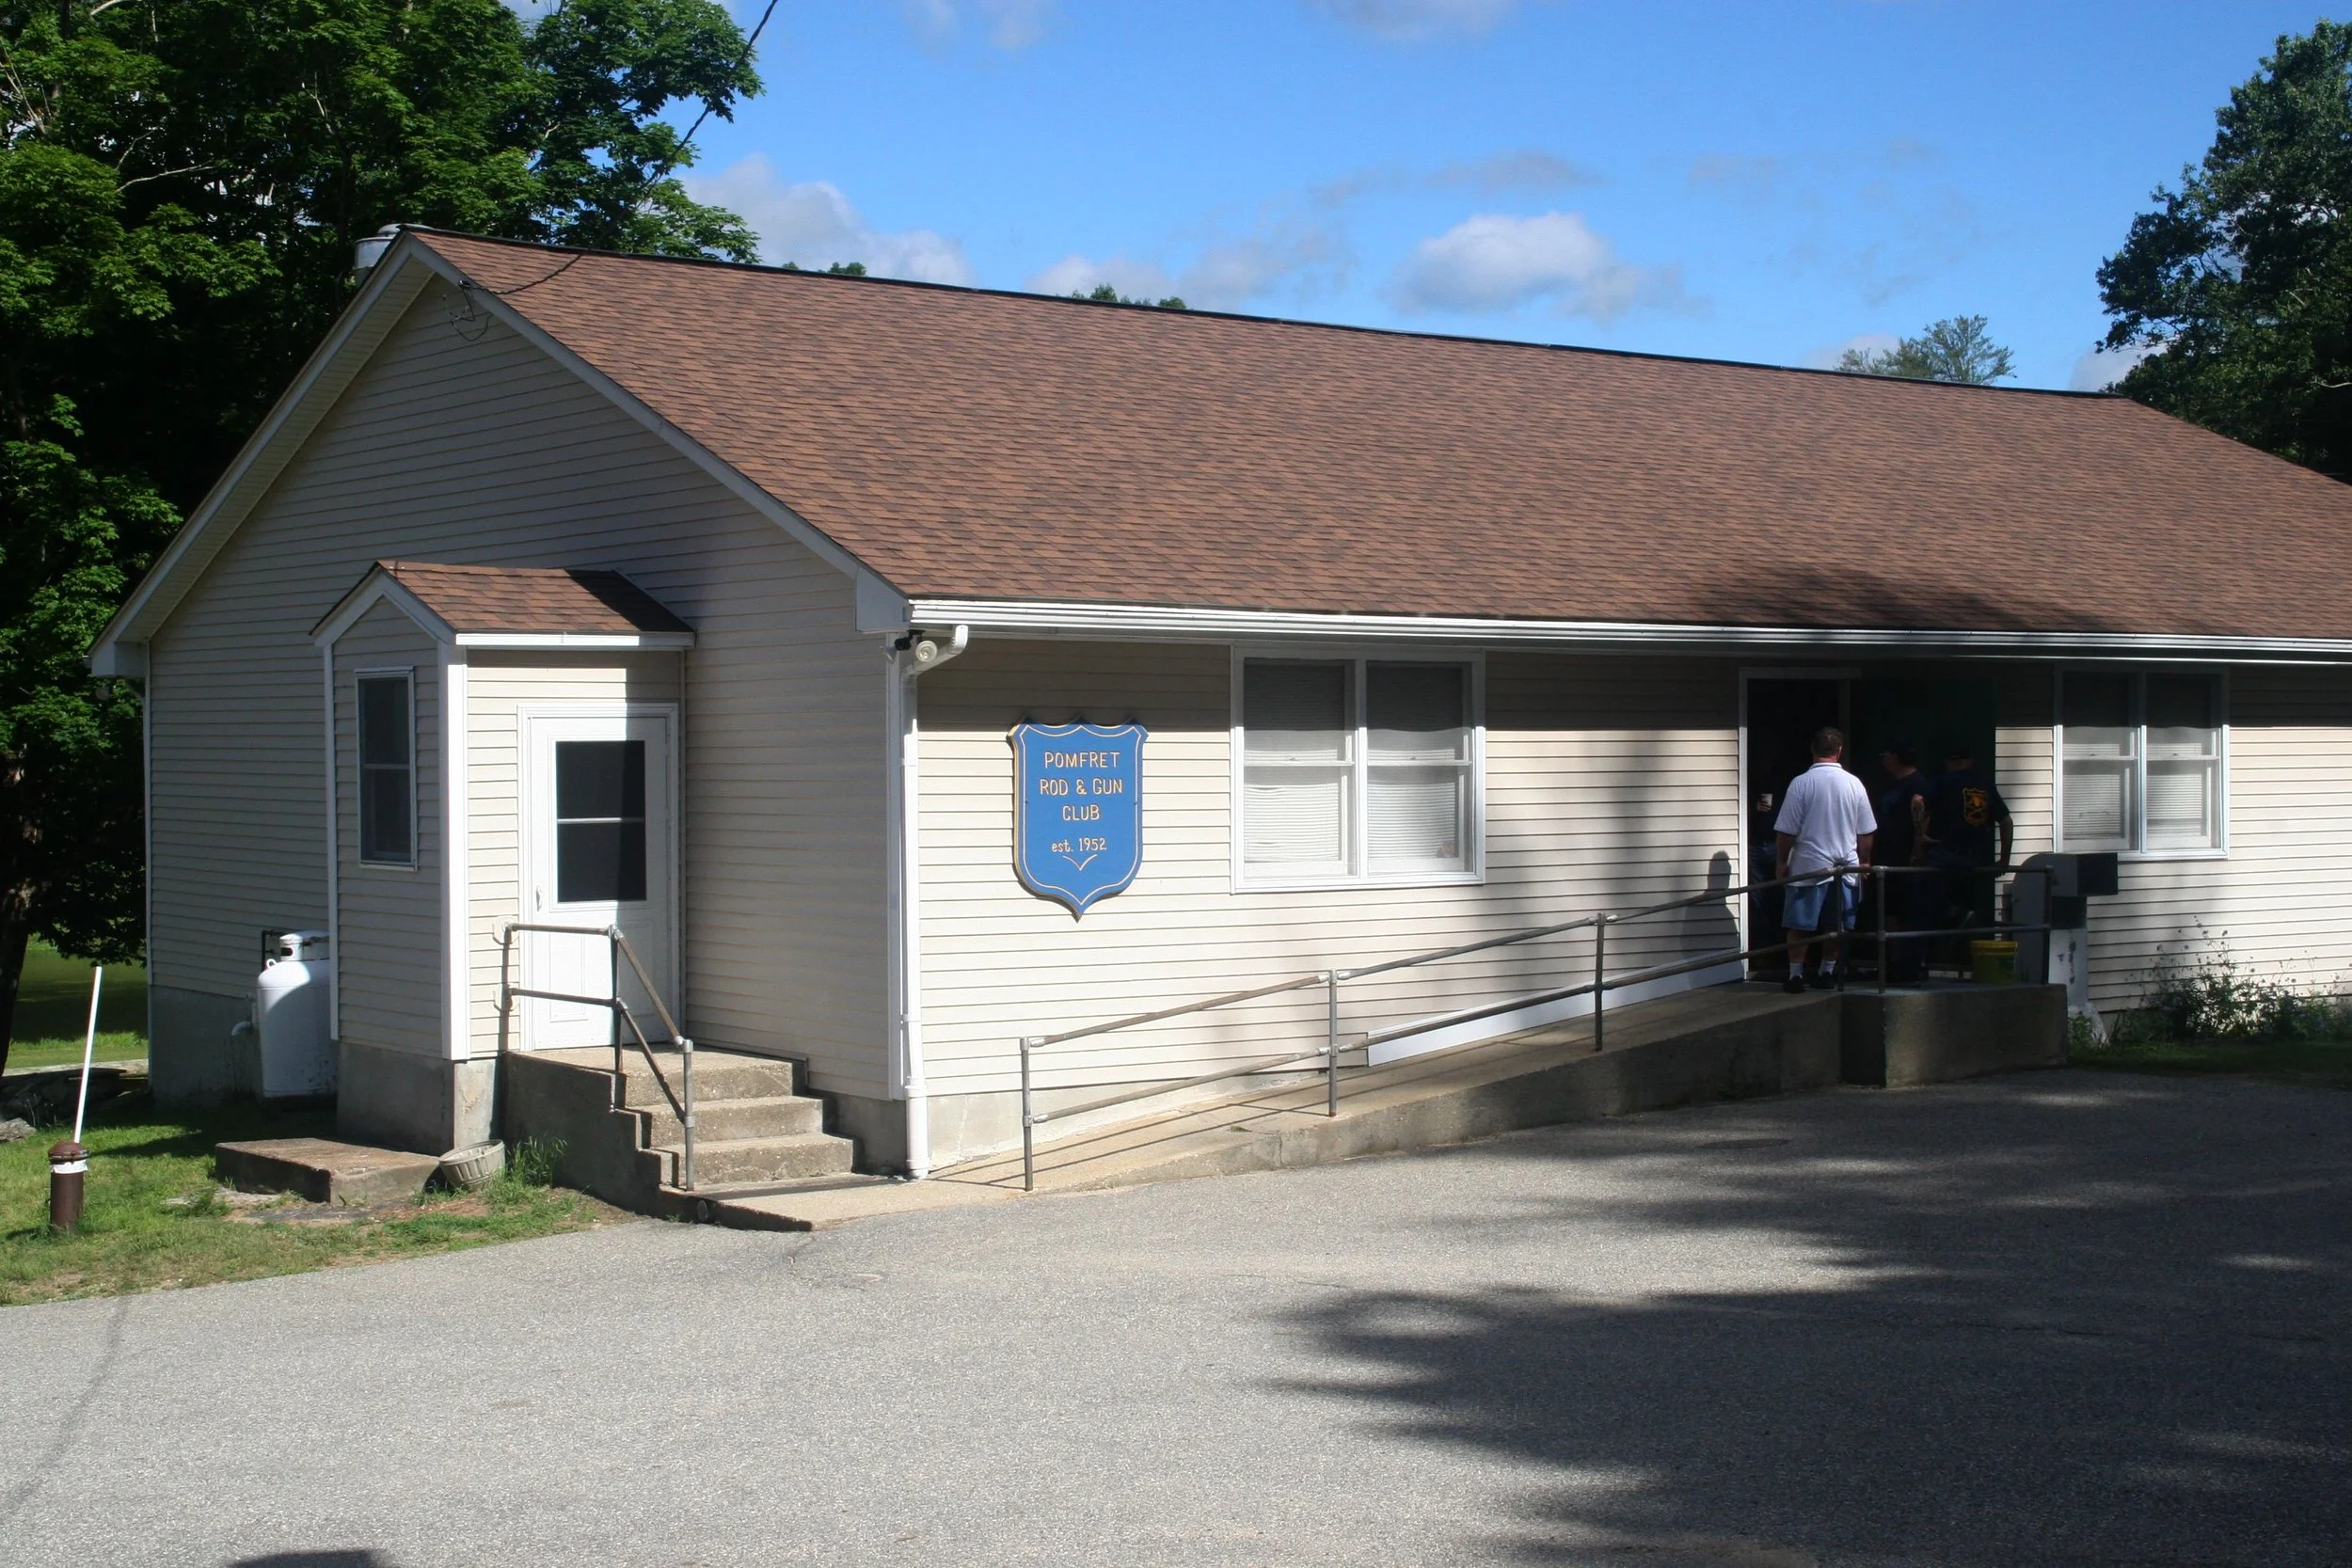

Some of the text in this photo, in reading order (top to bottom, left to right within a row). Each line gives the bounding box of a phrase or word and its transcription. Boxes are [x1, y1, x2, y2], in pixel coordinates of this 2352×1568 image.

[1044, 752, 1120, 768] POMFRET
[1040, 778, 1122, 795] ROD & GUN
[1062, 804, 1100, 821] CLUB
[1051, 837, 1107, 852] est. 1952
